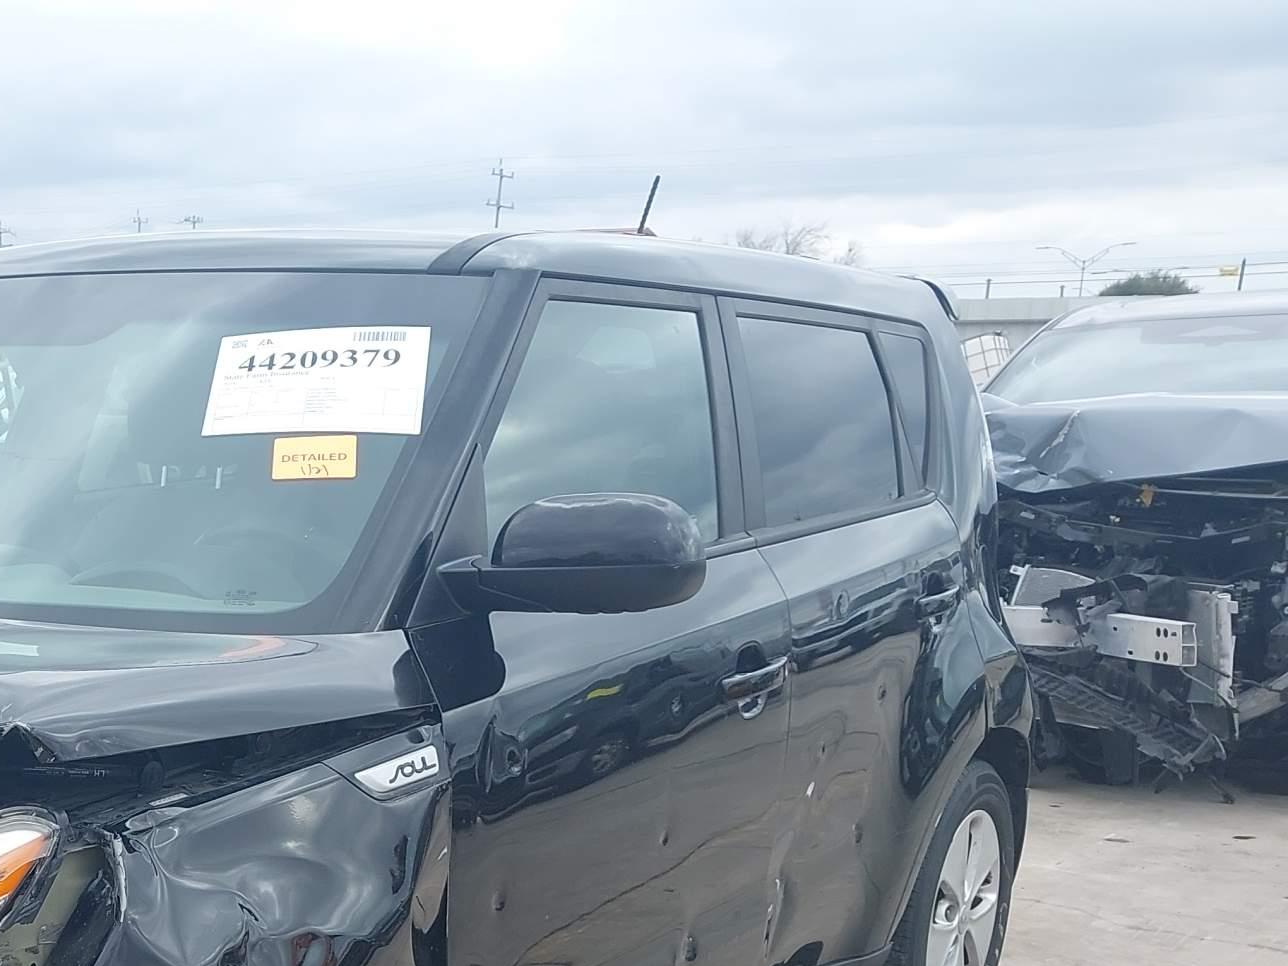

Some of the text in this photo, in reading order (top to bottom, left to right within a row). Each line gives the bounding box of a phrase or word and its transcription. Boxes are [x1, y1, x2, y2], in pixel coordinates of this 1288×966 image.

[238, 348, 401, 373] 44209379
[281, 453, 348, 463] DETAILED
[388, 756, 437, 784] SOUL
